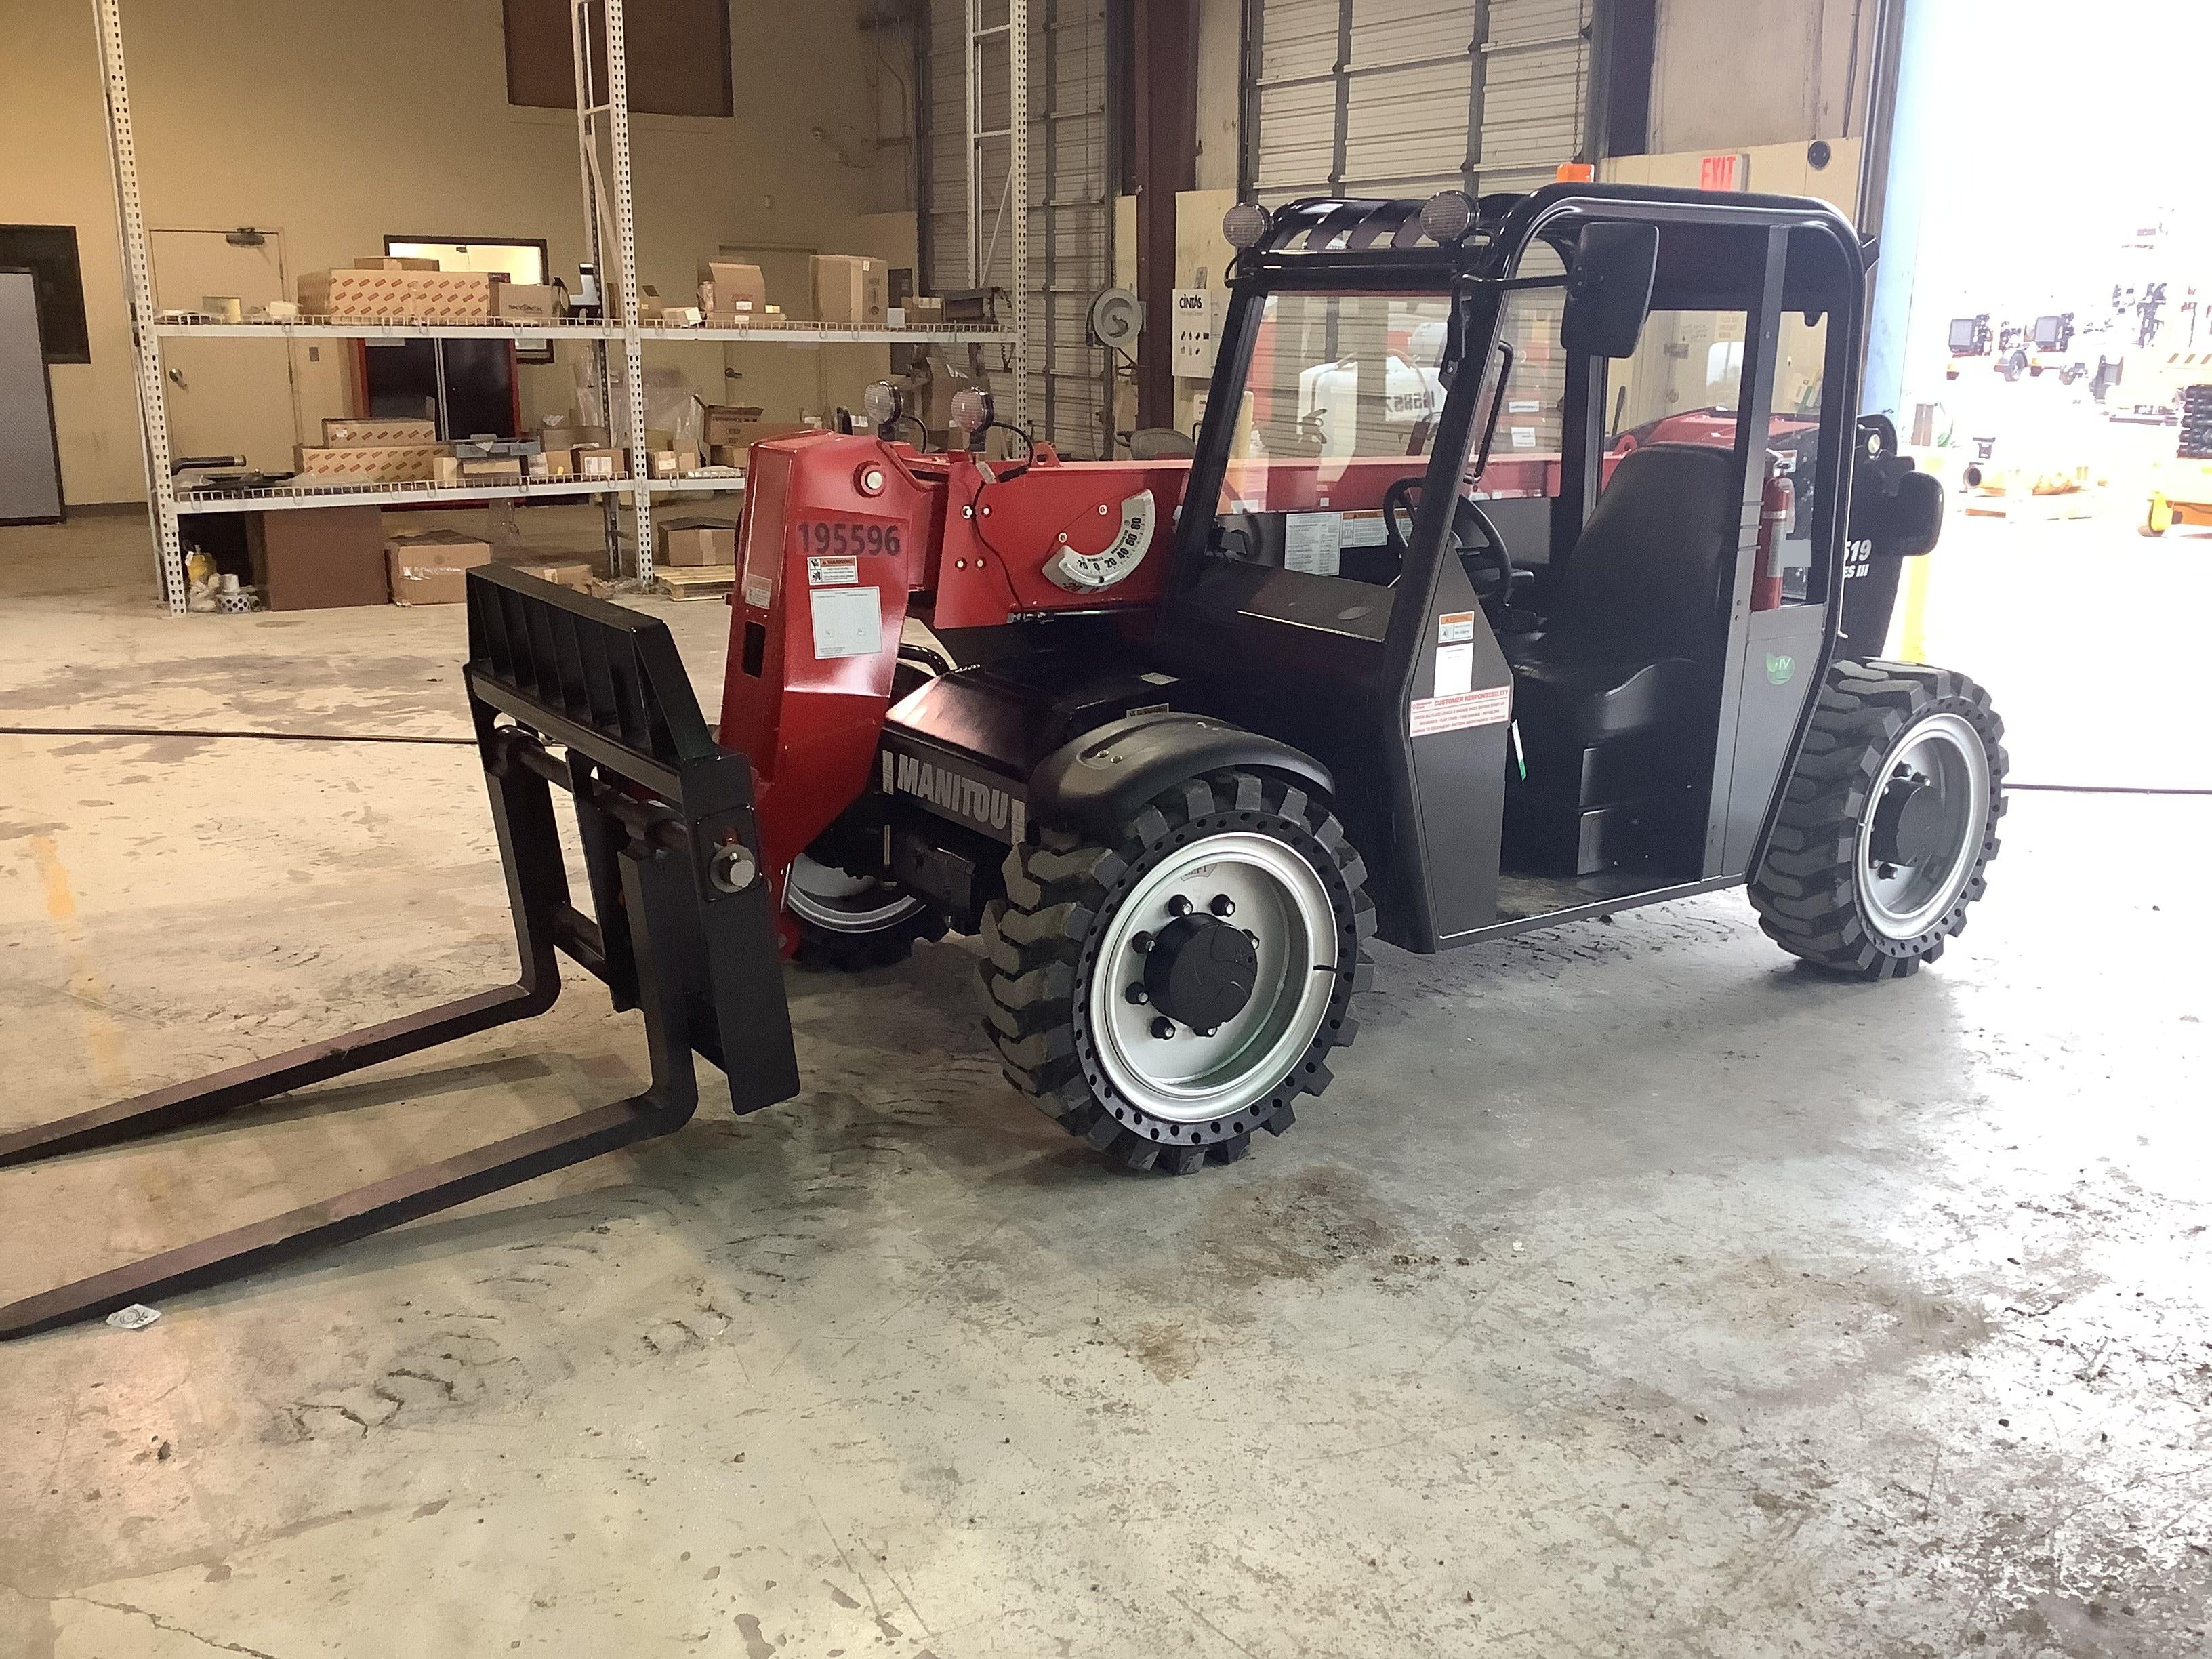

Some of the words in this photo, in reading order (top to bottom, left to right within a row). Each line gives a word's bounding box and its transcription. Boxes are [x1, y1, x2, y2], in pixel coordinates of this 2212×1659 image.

[1702, 156, 1736, 190] EXIT
[1179, 293, 1202, 309] CINTAS
[1131, 517, 1142, 530] 80
[798, 522, 901, 556] 195596
[1126, 533, 1138, 546] 60
[1117, 547, 1129, 559] 40
[1104, 557, 1117, 568] 20
[1435, 696, 1463, 706] CUSTOMER
[1465, 689, 1508, 701] RESPONSIBILITY
[897, 754, 1009, 830] MANITOU
